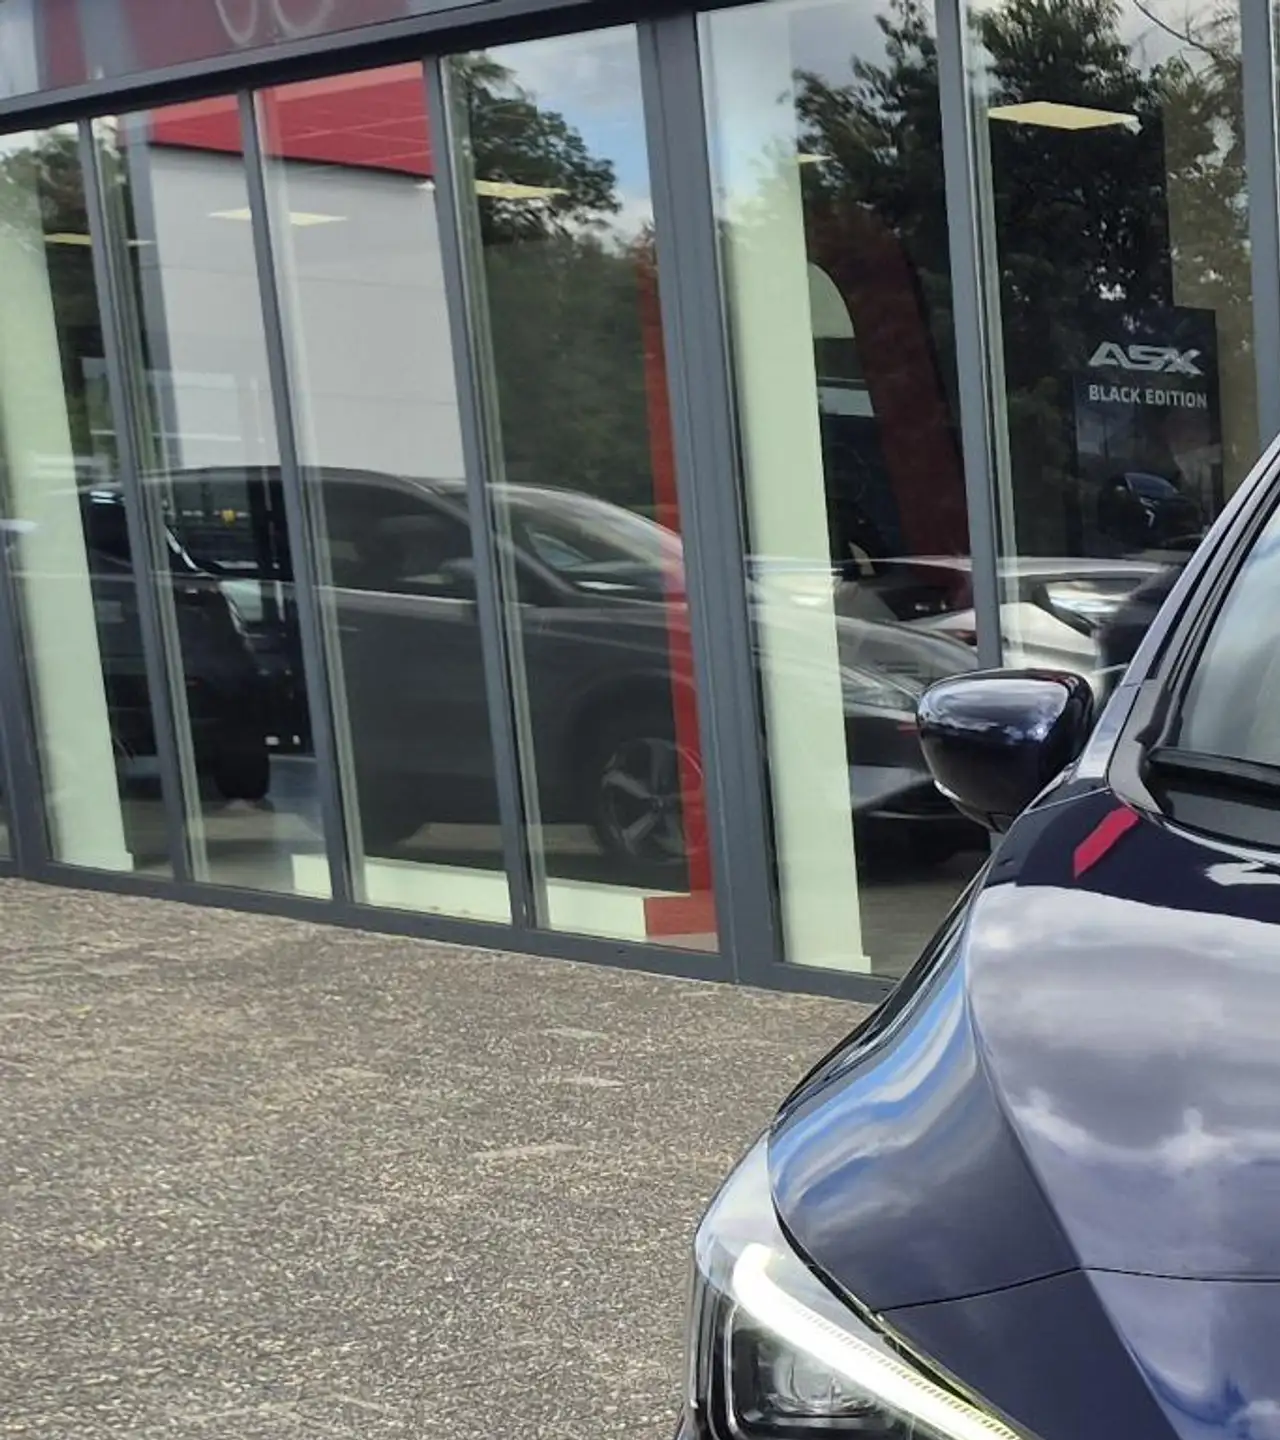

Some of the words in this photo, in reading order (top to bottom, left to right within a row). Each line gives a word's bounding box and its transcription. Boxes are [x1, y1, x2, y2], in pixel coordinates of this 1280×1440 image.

[1088, 341, 1203, 375] ASX
[1088, 384, 1141, 404] BLACK
[1145, 388, 1208, 409] EDITION
